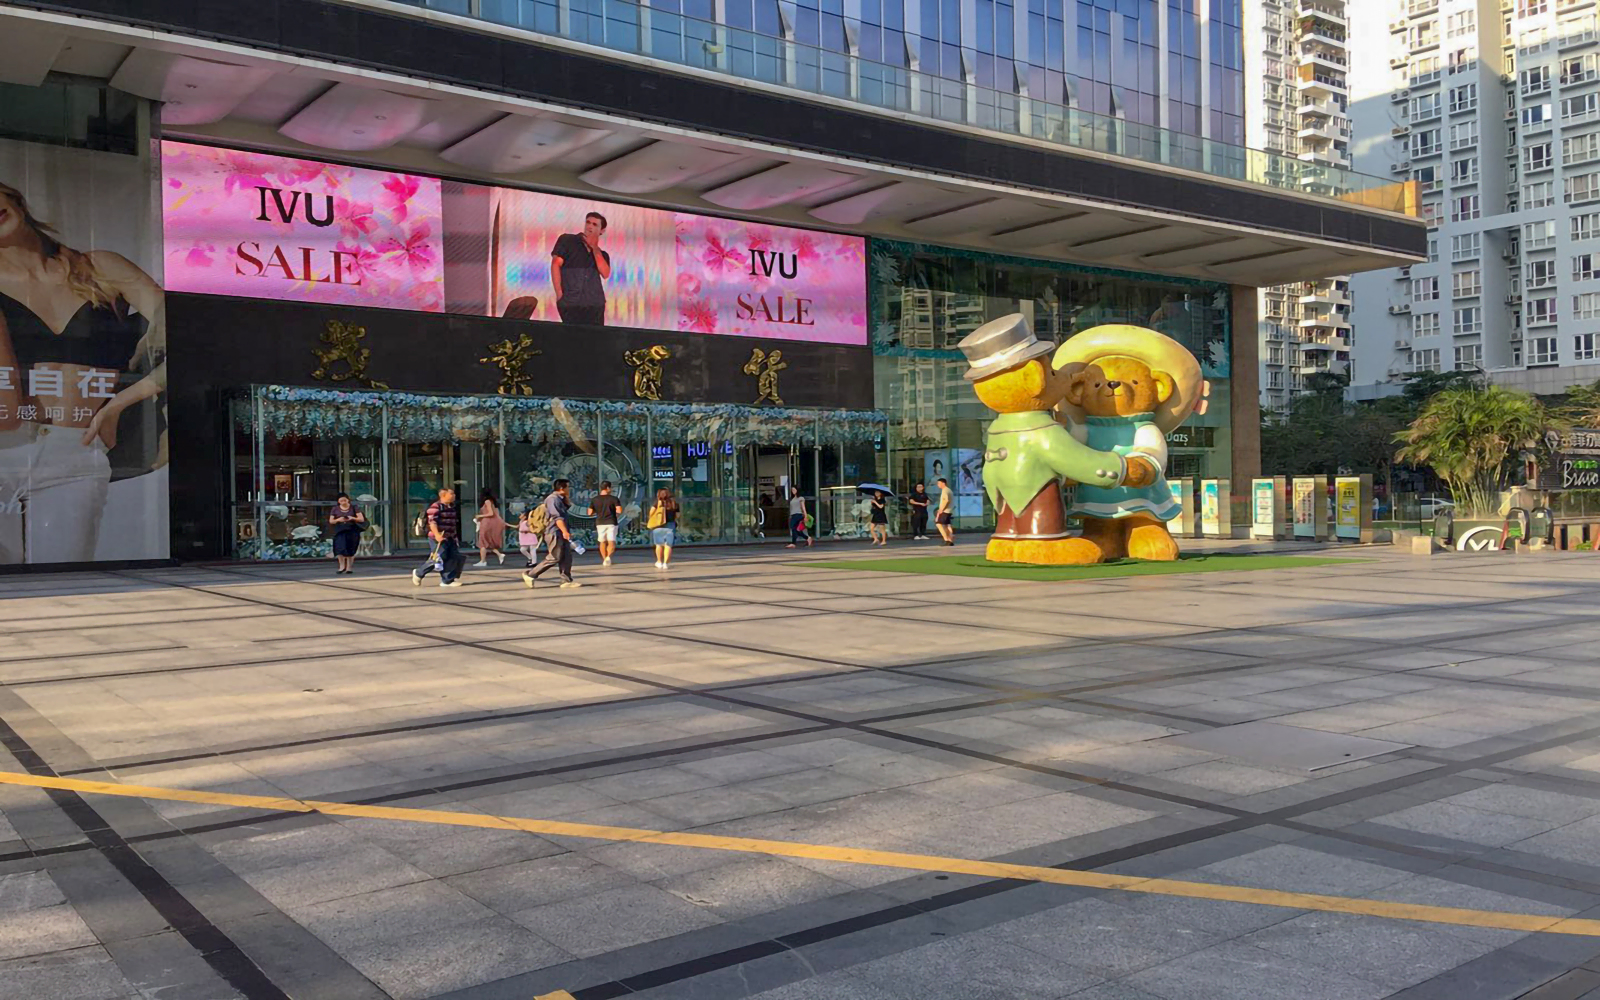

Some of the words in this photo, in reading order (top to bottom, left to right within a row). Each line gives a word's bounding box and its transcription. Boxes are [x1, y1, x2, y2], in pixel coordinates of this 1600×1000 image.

[255, 186, 334, 227] IVU
[235, 240, 362, 286] SALE
[748, 249, 798, 280] IVU
[736, 292, 815, 326] SALE
[1562, 460, 1599, 489] Bravo
